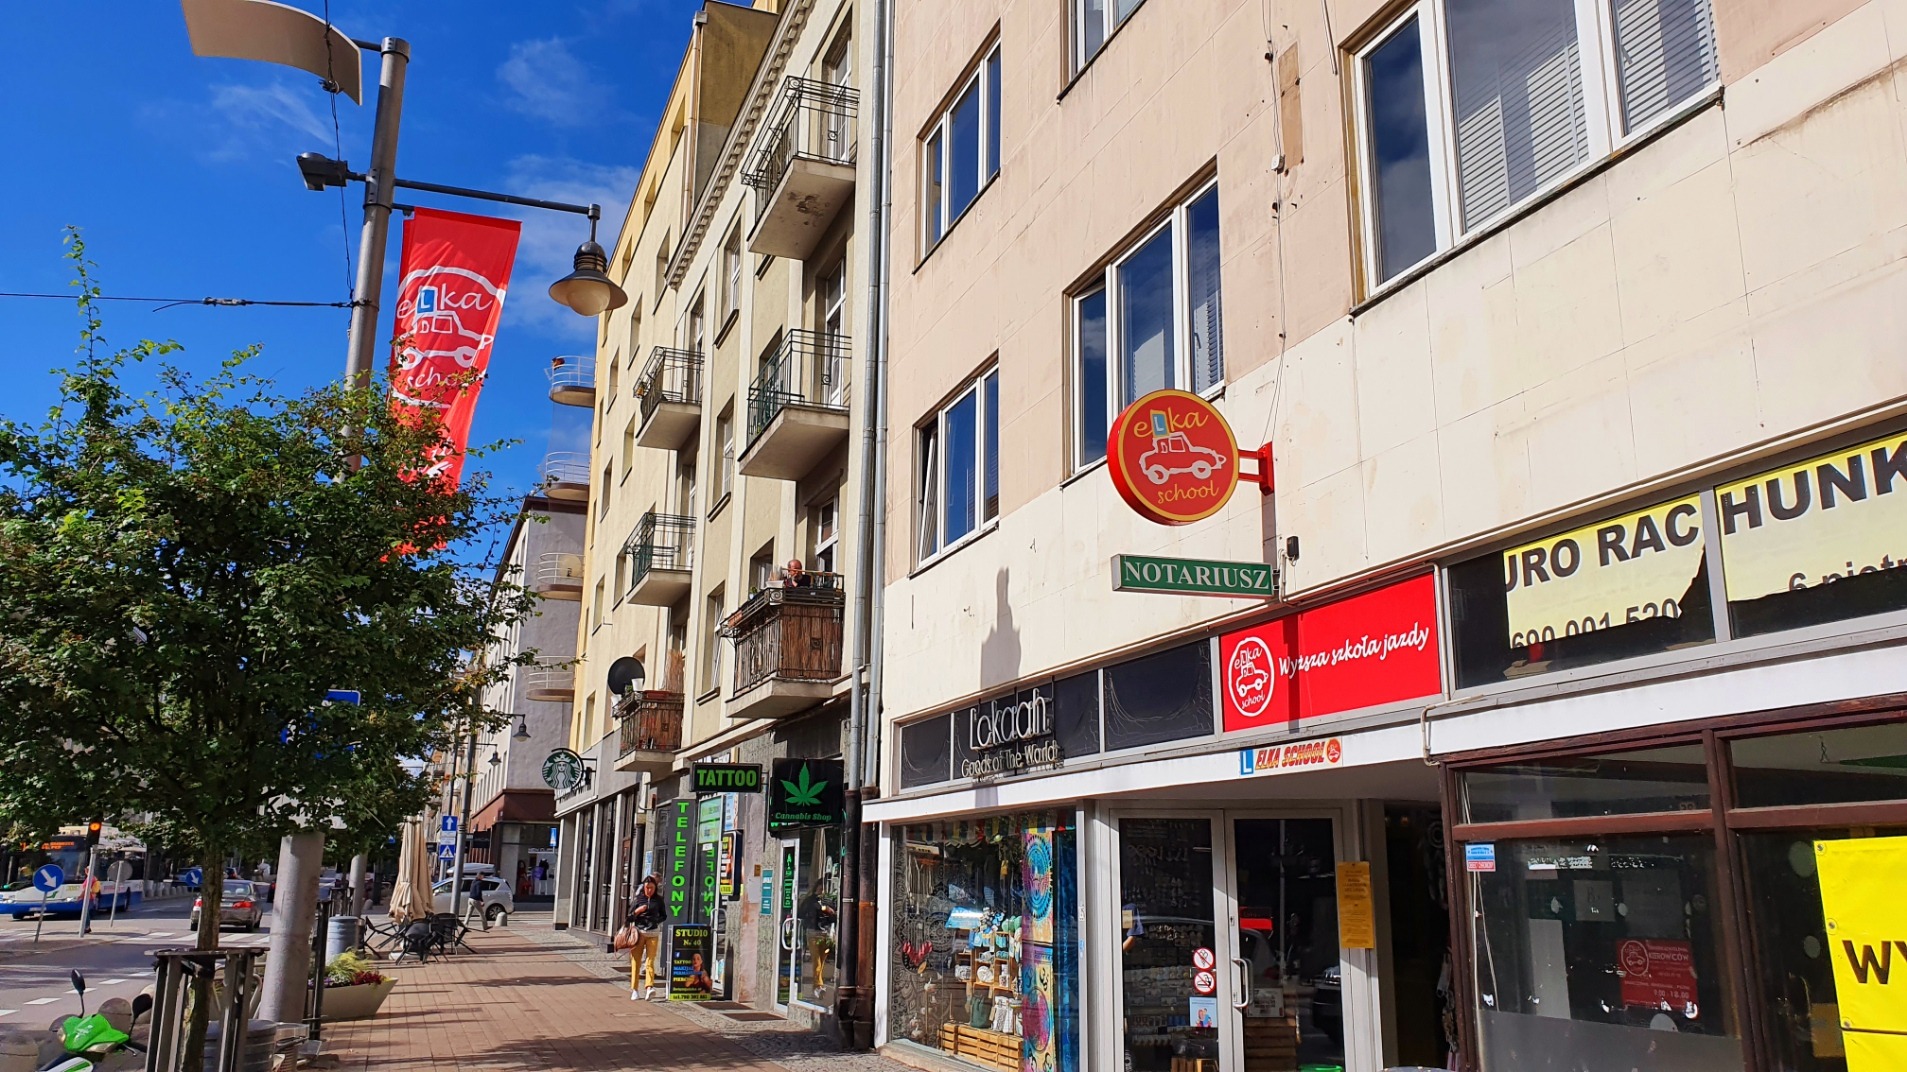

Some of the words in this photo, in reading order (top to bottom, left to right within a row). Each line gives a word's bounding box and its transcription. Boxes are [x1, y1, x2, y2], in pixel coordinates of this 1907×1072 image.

[1157, 480, 1220, 505] school
[1124, 560, 1269, 590] NOTARIUSZ
[1379, 622, 1430, 665] jazdy
[1241, 690, 1266, 709] school
[1254, 747, 1281, 771] ELKA
[1281, 741, 1326, 768] SCHOOL
[696, 768, 757, 787] TATTOO
[775, 811, 812, 821] Cannabis
[812, 812, 832, 823] Shop
[669, 802, 690, 917] TELEFONY
[675, 928, 709, 937] STUDIO
